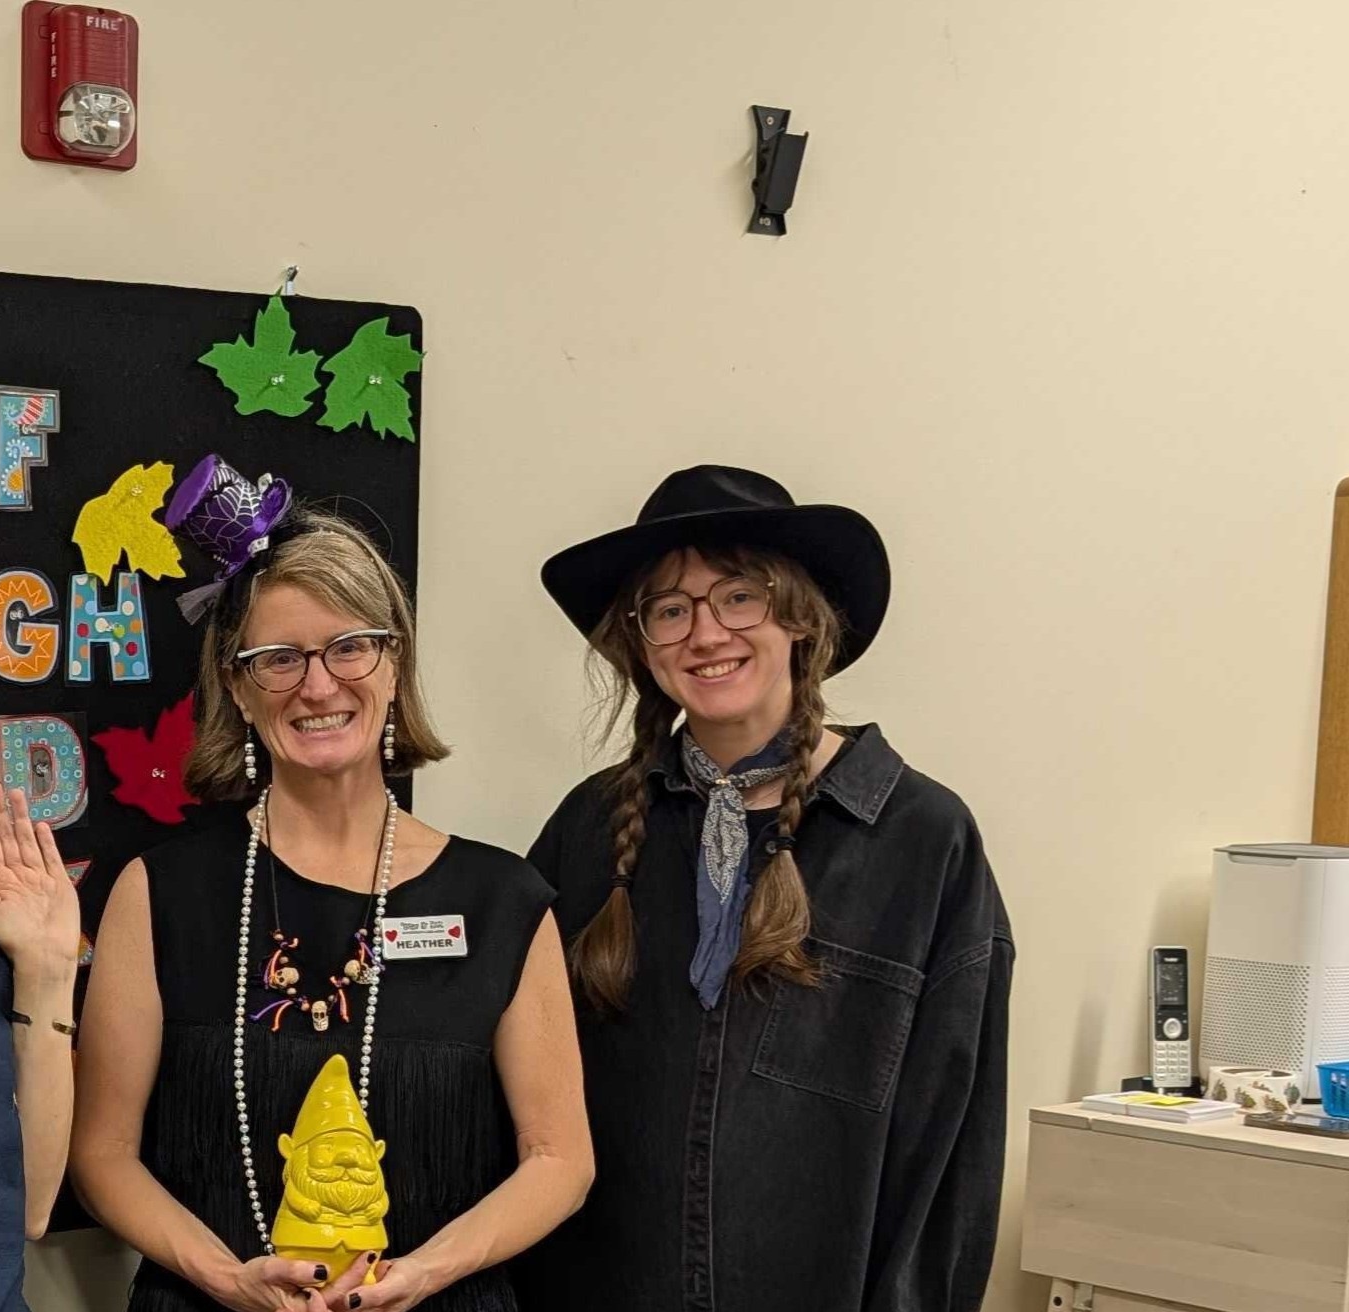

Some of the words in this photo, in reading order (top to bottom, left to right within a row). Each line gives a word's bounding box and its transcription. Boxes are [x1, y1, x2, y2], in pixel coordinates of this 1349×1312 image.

[86, 16, 119, 31] FIRE
[50, 31, 58, 78] FIRE
[396, 939, 453, 949] HEATHER
